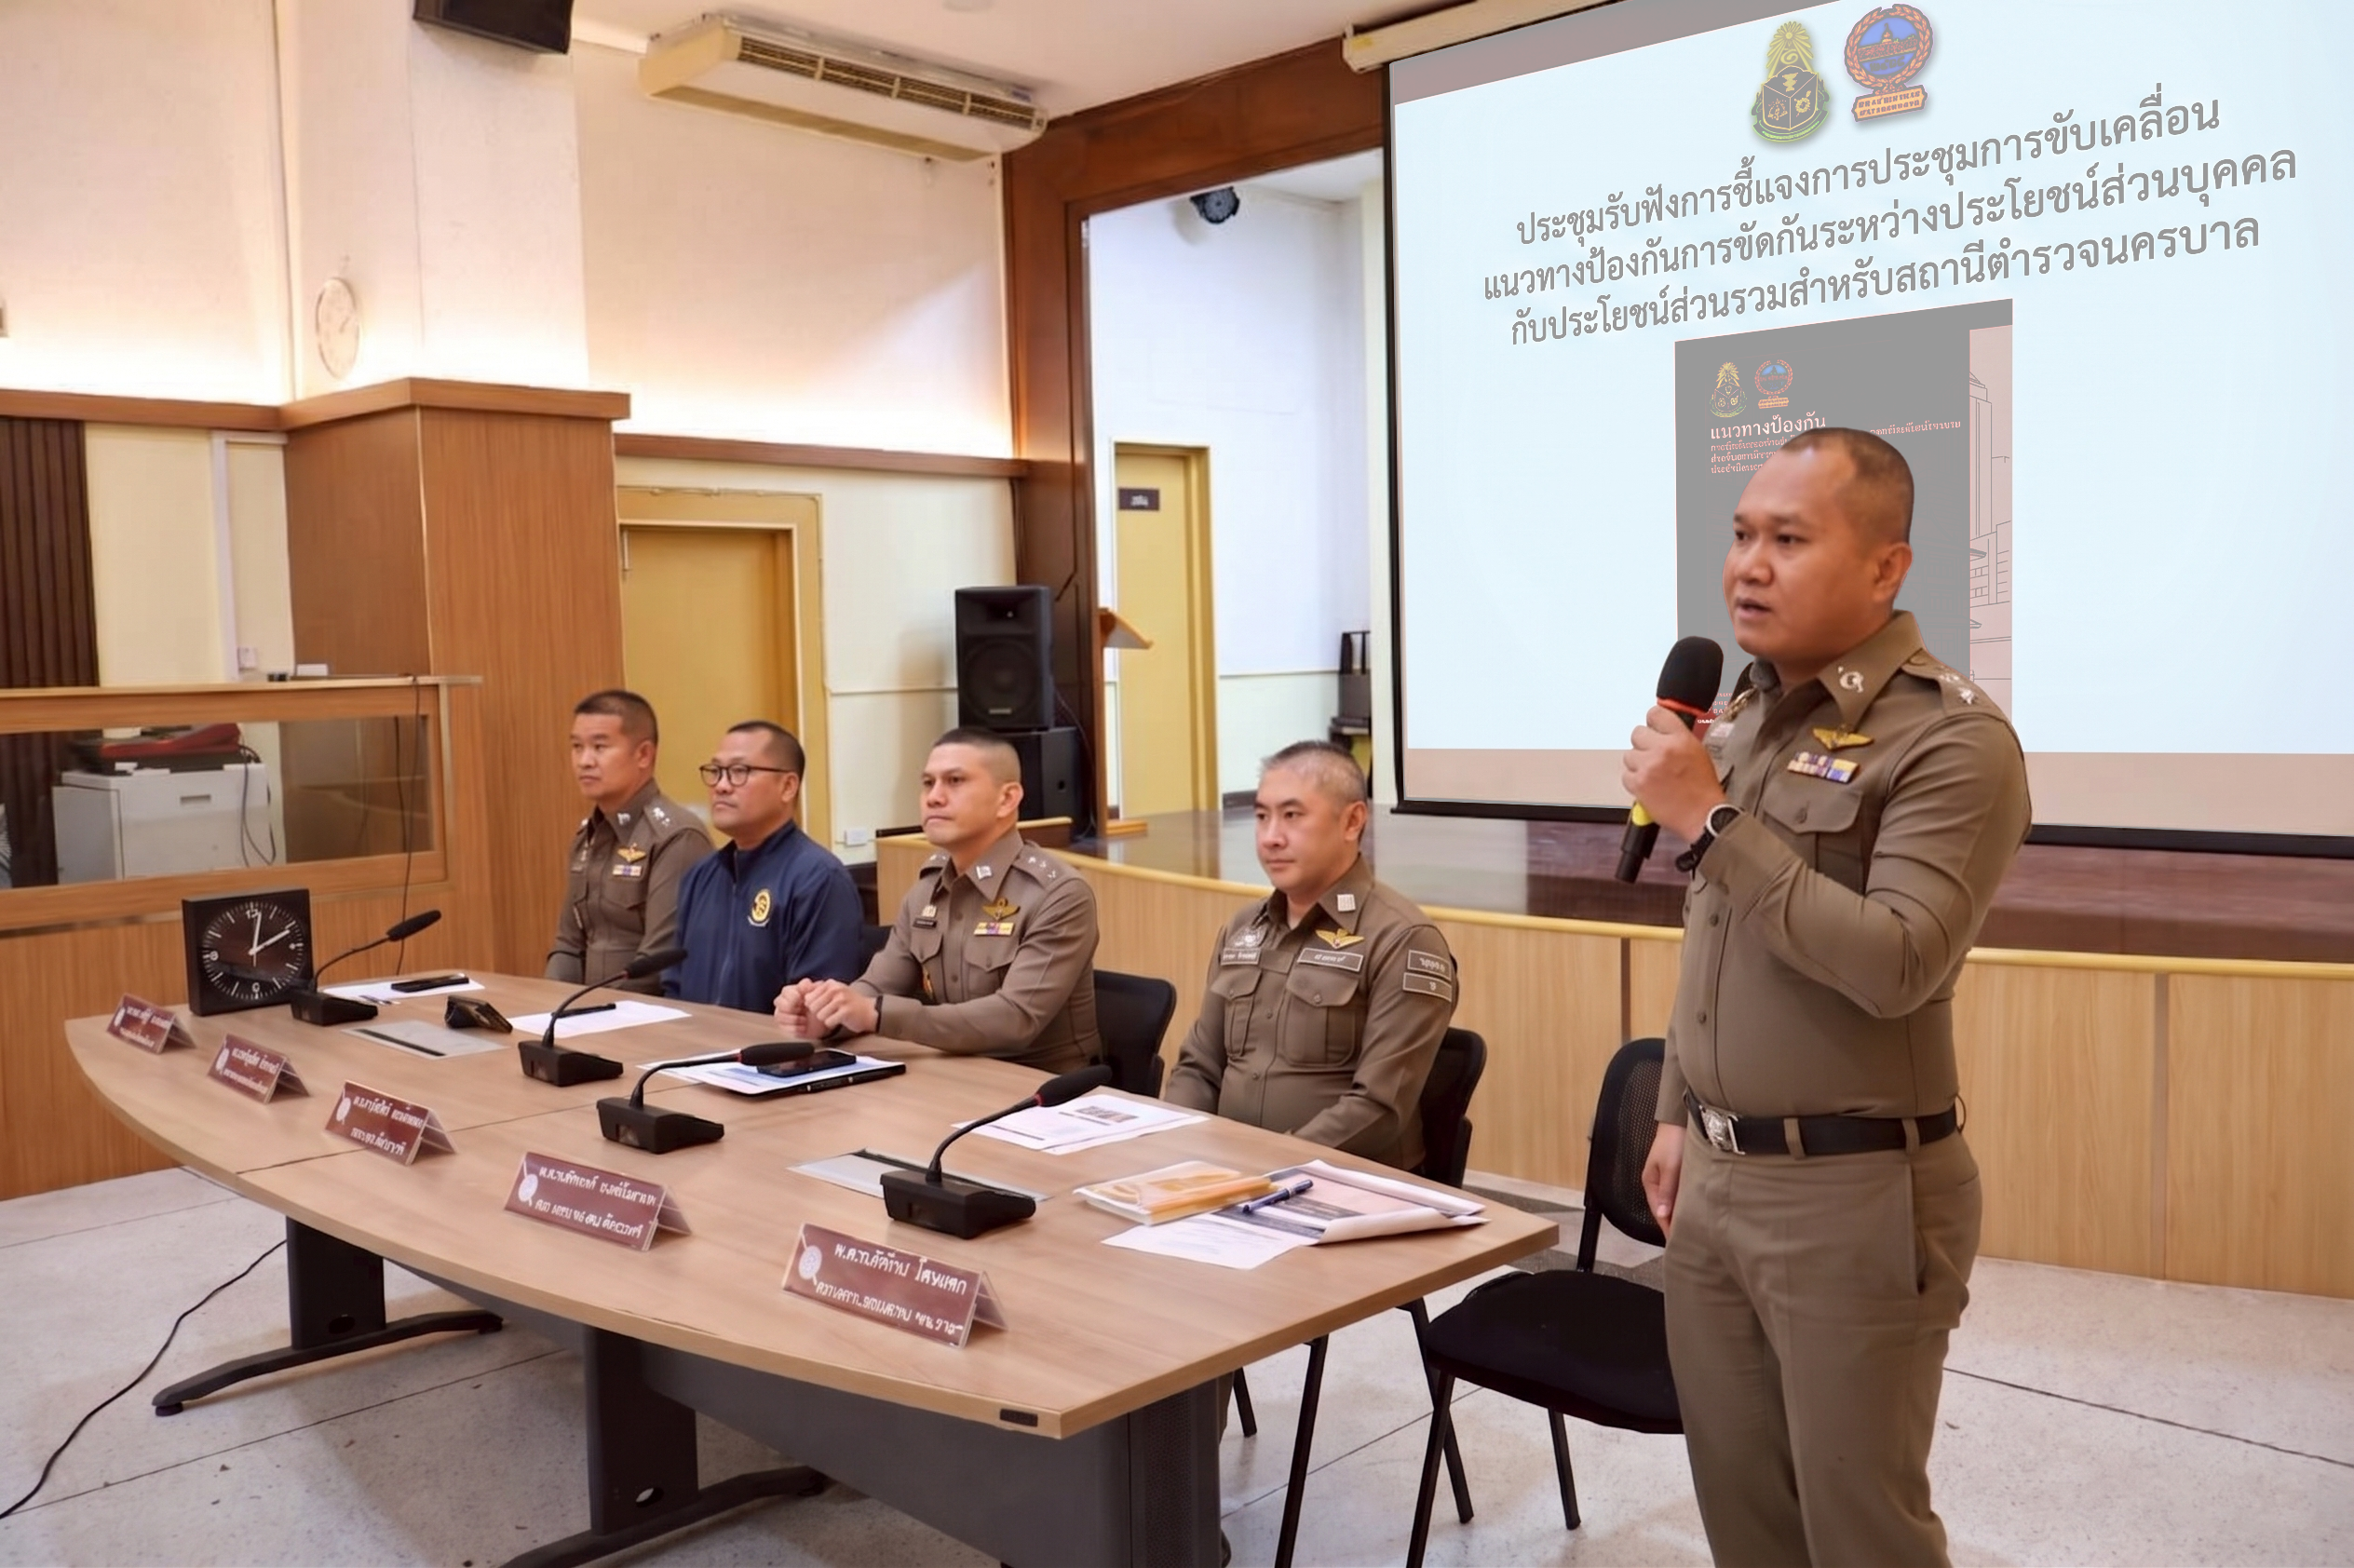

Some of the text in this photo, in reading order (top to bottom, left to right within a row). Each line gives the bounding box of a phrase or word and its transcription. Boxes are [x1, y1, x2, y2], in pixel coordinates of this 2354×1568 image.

[1483, 148, 2298, 301] แนวทางป้องกันการขัดกันระหว่างประโยชน์ส่วนบุคคล
[1516, 82, 2221, 248] ประชุมรับฟังการชี้แจงการประชุมการขับเคลื่อน
[1510, 216, 2261, 345] กับประโยชน์ส่วนรวมสำหรับสถานีตำรวจนครบาล
